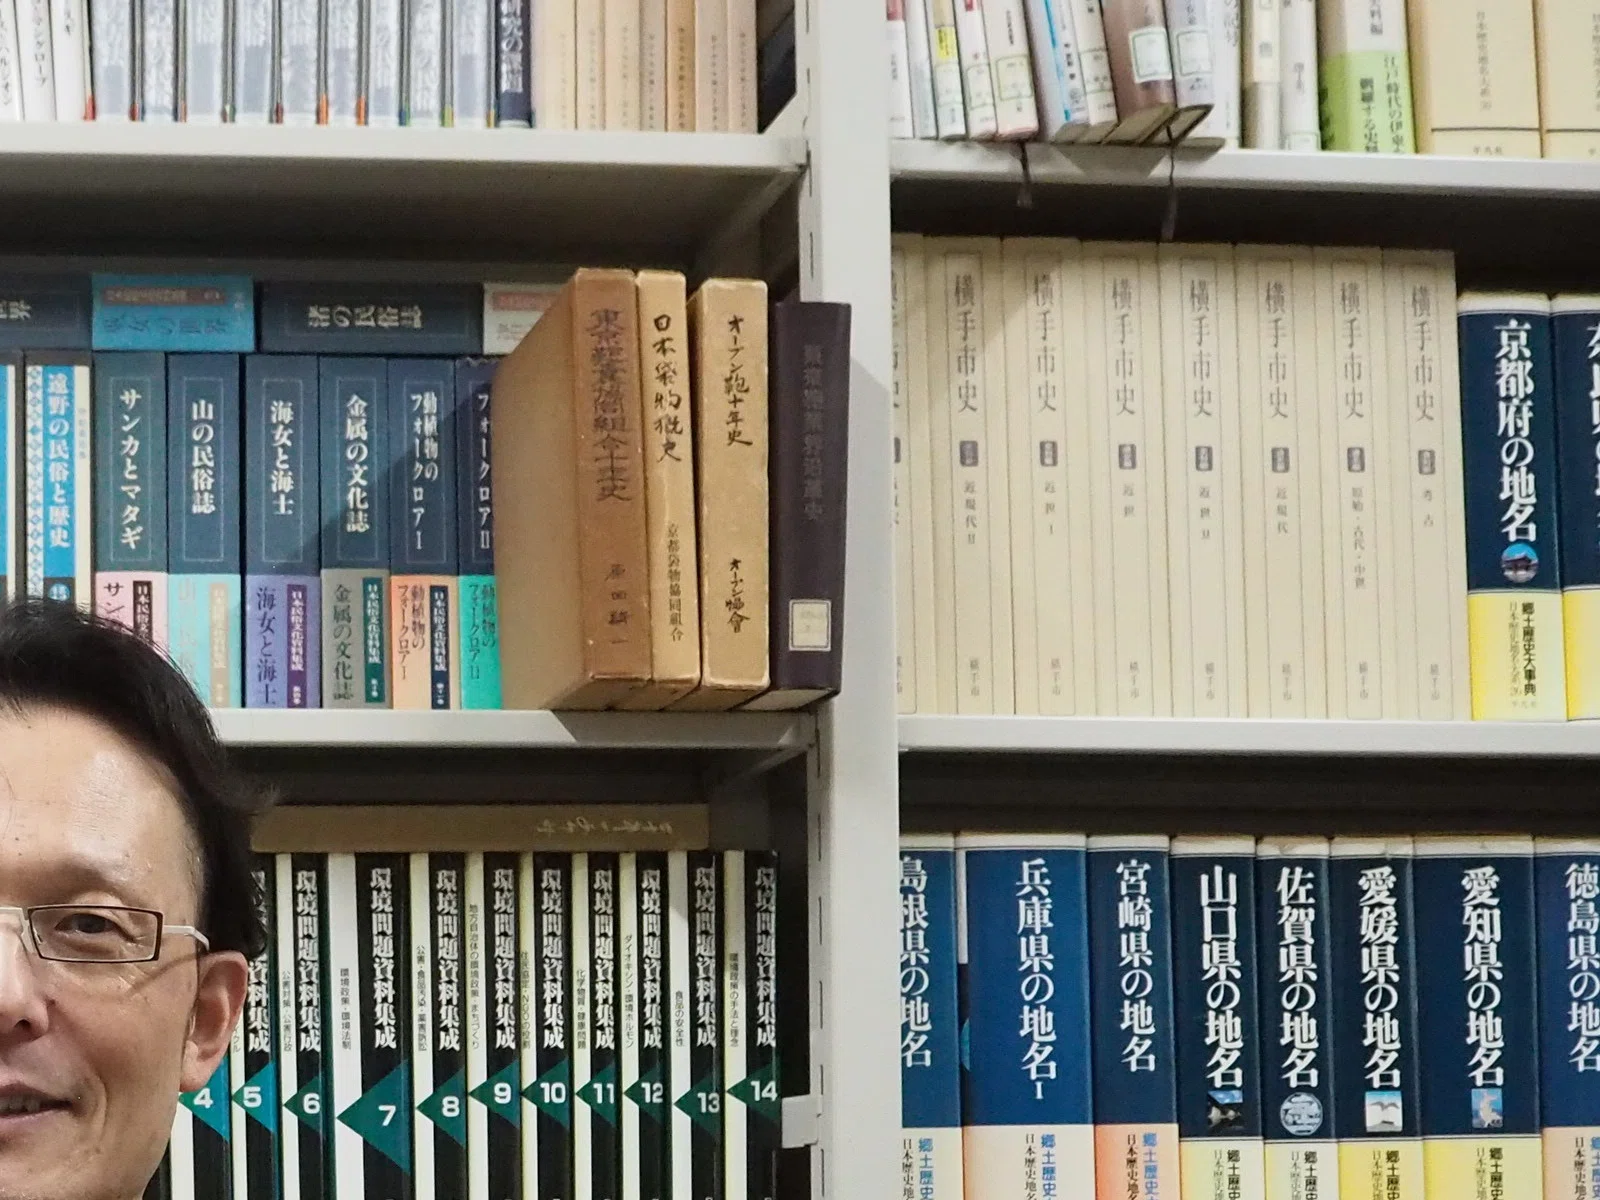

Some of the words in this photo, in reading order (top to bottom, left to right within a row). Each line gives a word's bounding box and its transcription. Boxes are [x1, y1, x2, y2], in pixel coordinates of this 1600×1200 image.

[308, 304, 424, 329] 渚の民俗誌
[955, 274, 977, 413] 横手市史
[1035, 273, 1057, 413] 横手市史
[1112, 277, 1136, 416] 横手市史
[1190, 279, 1212, 418] 横手市史
[1265, 280, 1289, 419] 横手市史
[1341, 281, 1365, 420] 横手市史
[1411, 284, 1434, 422] 横手市史
[48, 372, 71, 548] 遠野の民俗と歴史
[119, 388, 144, 550] サンカとマタギ
[191, 398, 216, 515] 山の民俗誌
[270, 400, 294, 515] 海女と海士
[345, 393, 370, 534] 金属の文化誌
[423, 391, 438, 482] 動植物の
[1494, 318, 1537, 543] 京都府の地名
[256, 586, 278, 706] 海女と海士
[332, 583, 355, 701] 金属の文化誌
[411, 584, 425, 650] 動植物の
[1521, 602, 1537, 697] 郷土歴史大事典
[295, 869, 321, 1052] 環境問題資料集成
[369, 867, 397, 1049] 環境問題資料集成
[436, 869, 460, 1051] 環境問題資料集成
[492, 868, 517, 1050] 環境問題資料集成
[542, 868, 565, 1049] 環境問題資料集成
[594, 868, 615, 1050] 環境問題資料集成
[641, 868, 663, 1050] 環境問題資料集成
[694, 867, 717, 1048] 環境問題資料集成
[755, 866, 777, 1048] 環境問題資料集成
[900, 856, 932, 1068] 島根県の地名
[1116, 858, 1156, 1072] 宮崎県の地名
[1200, 864, 1243, 1087] 山口県の地名
[1276, 865, 1320, 1088] 佐賀県の地名
[1358, 865, 1400, 1088] 愛媛県の地名
[1461, 865, 1505, 1088] 愛知県の地名
[1565, 862, 1600, 1073] 徳島県の地名
[193, 1087, 213, 1109] 4
[242, 1086, 262, 1108] 5
[302, 1093, 321, 1114] 6
[378, 1105, 396, 1127] 7
[441, 1095, 460, 1118] 8
[493, 1082, 512, 1104] 9
[540, 1082, 566, 1104] 10
[592, 1082, 615, 1104] 11
[640, 1082, 664, 1104] 12
[697, 1092, 720, 1114] 13
[750, 1080, 778, 1102] 14
